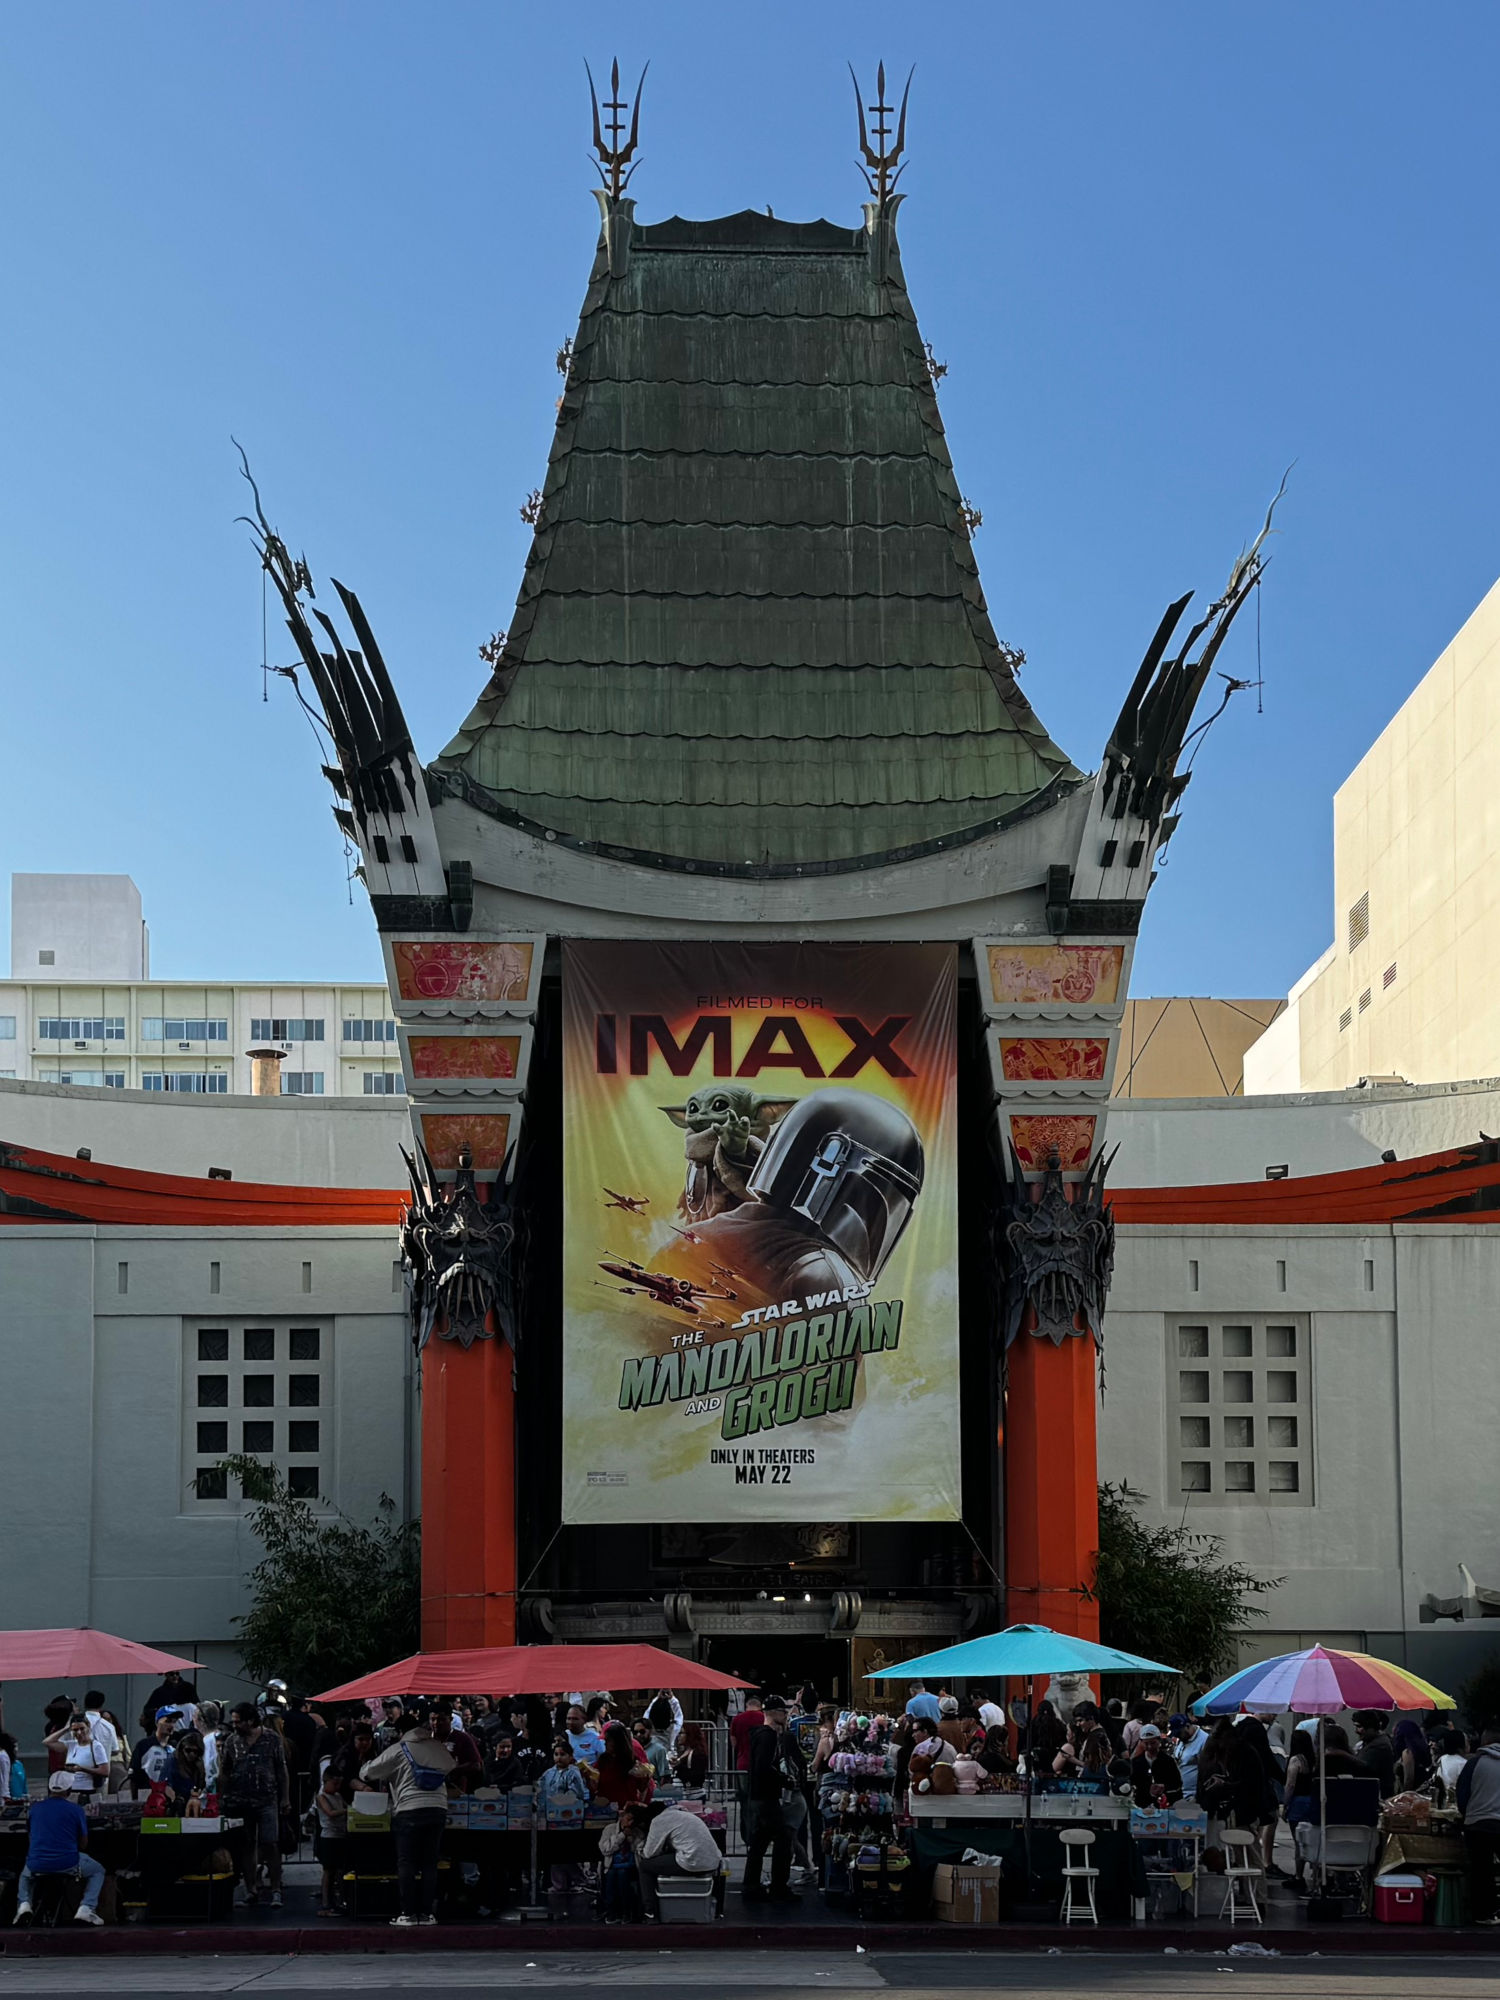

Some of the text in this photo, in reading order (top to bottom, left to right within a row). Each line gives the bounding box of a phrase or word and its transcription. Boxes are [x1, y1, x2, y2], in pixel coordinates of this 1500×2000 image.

[696, 996, 824, 1010] FILMED FOR
[596, 1013, 918, 1079] IMAX
[731, 1280, 876, 1330] STAR WARS
[618, 1299, 904, 1412] MANDALORIAN
[671, 1330, 705, 1348] THE
[684, 1359, 857, 1441] AND GROGU
[710, 1450, 815, 1464] ONLY IN THEATERS
[735, 1465, 791, 1484] MAY 22
